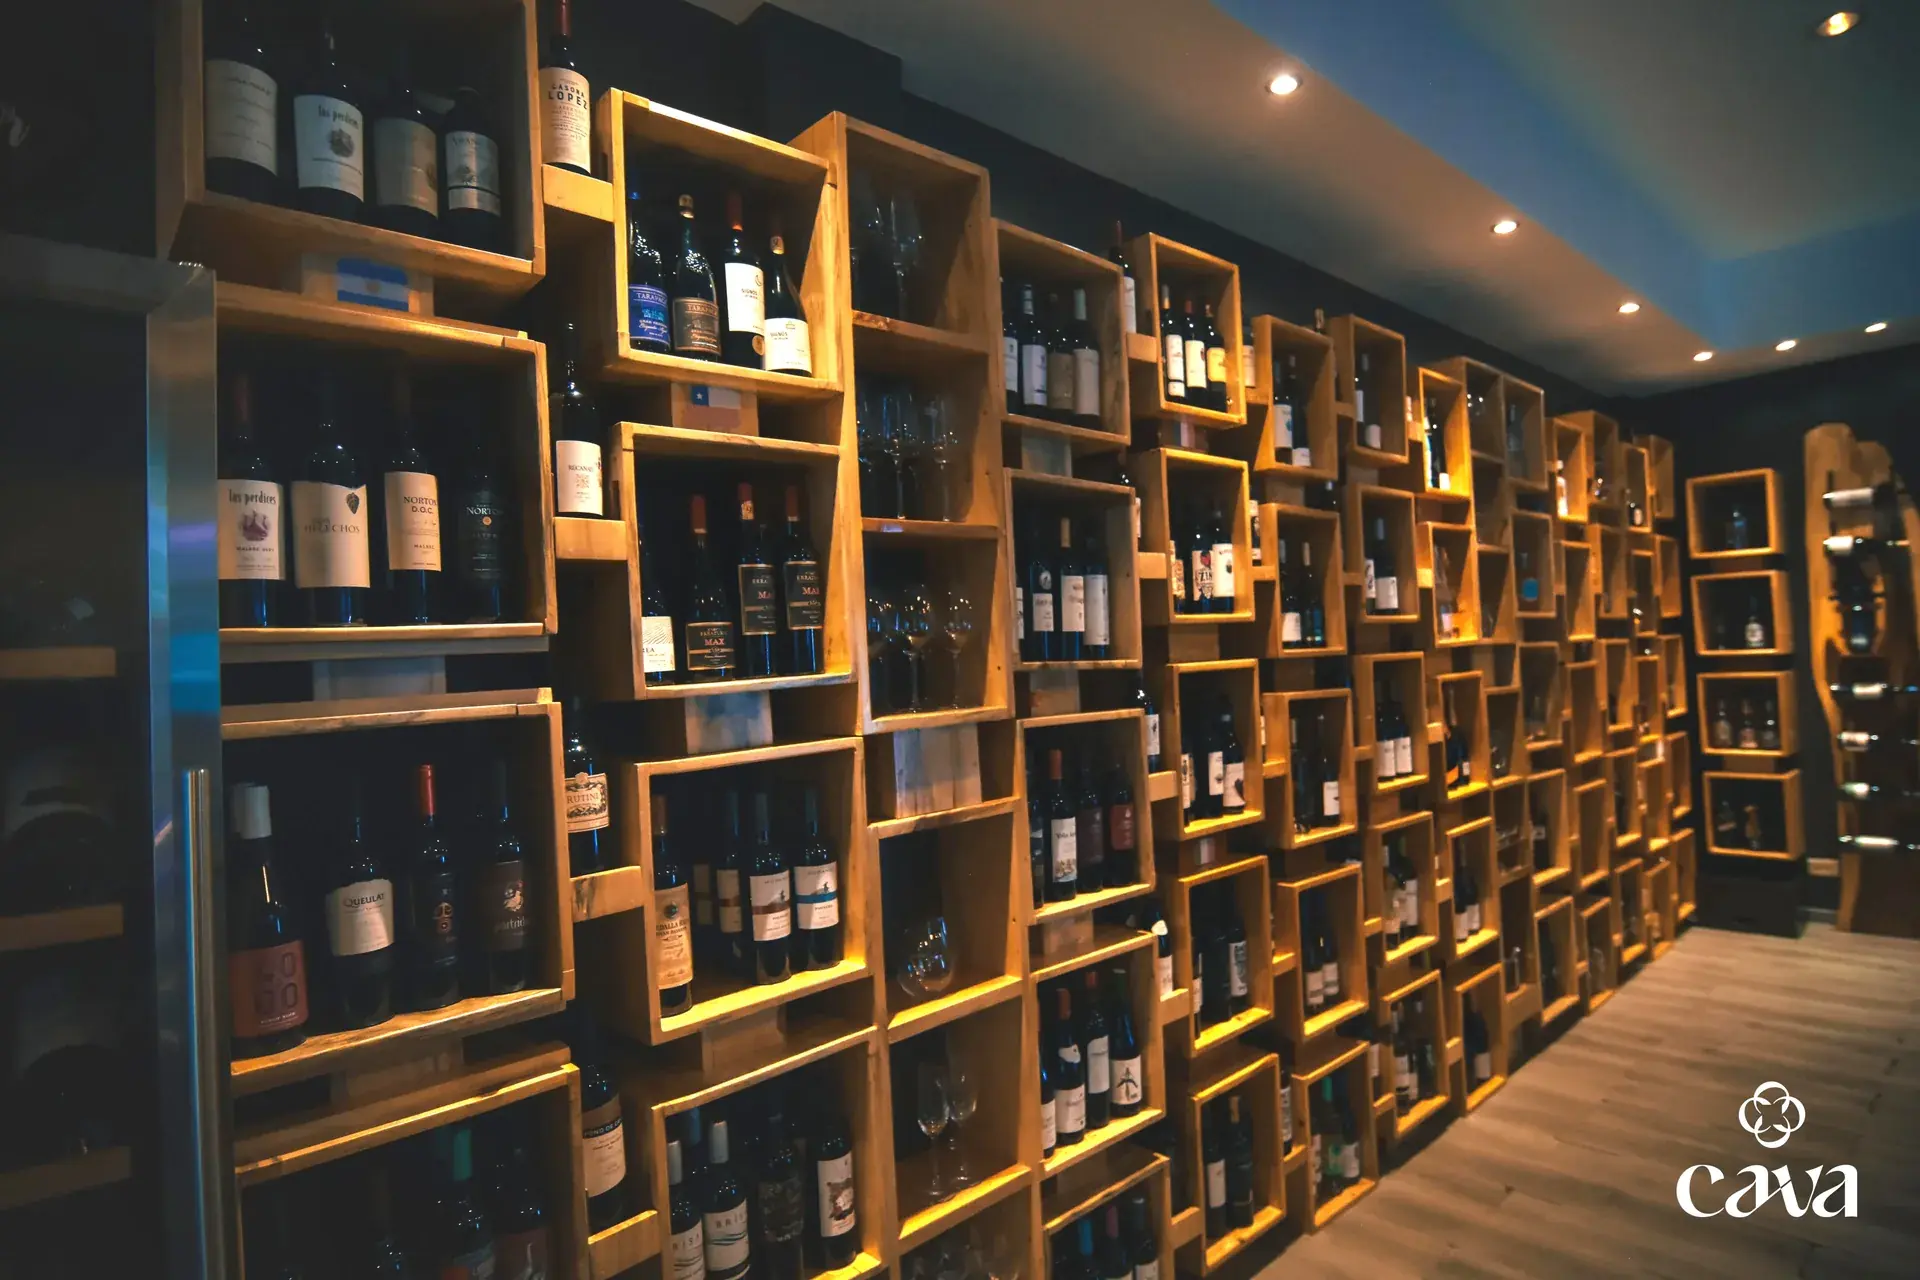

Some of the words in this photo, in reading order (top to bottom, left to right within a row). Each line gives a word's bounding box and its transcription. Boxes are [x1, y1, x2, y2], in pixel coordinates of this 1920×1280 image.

[551, 83, 585, 98] CASONA
[548, 90, 588, 110] LOPEZ
[244, 489, 277, 506] perdices
[411, 505, 434, 515] D.O.C.
[704, 637, 725, 646] MAX
[567, 791, 599, 805] RUTINI
[342, 892, 385, 909] QUEULAT
